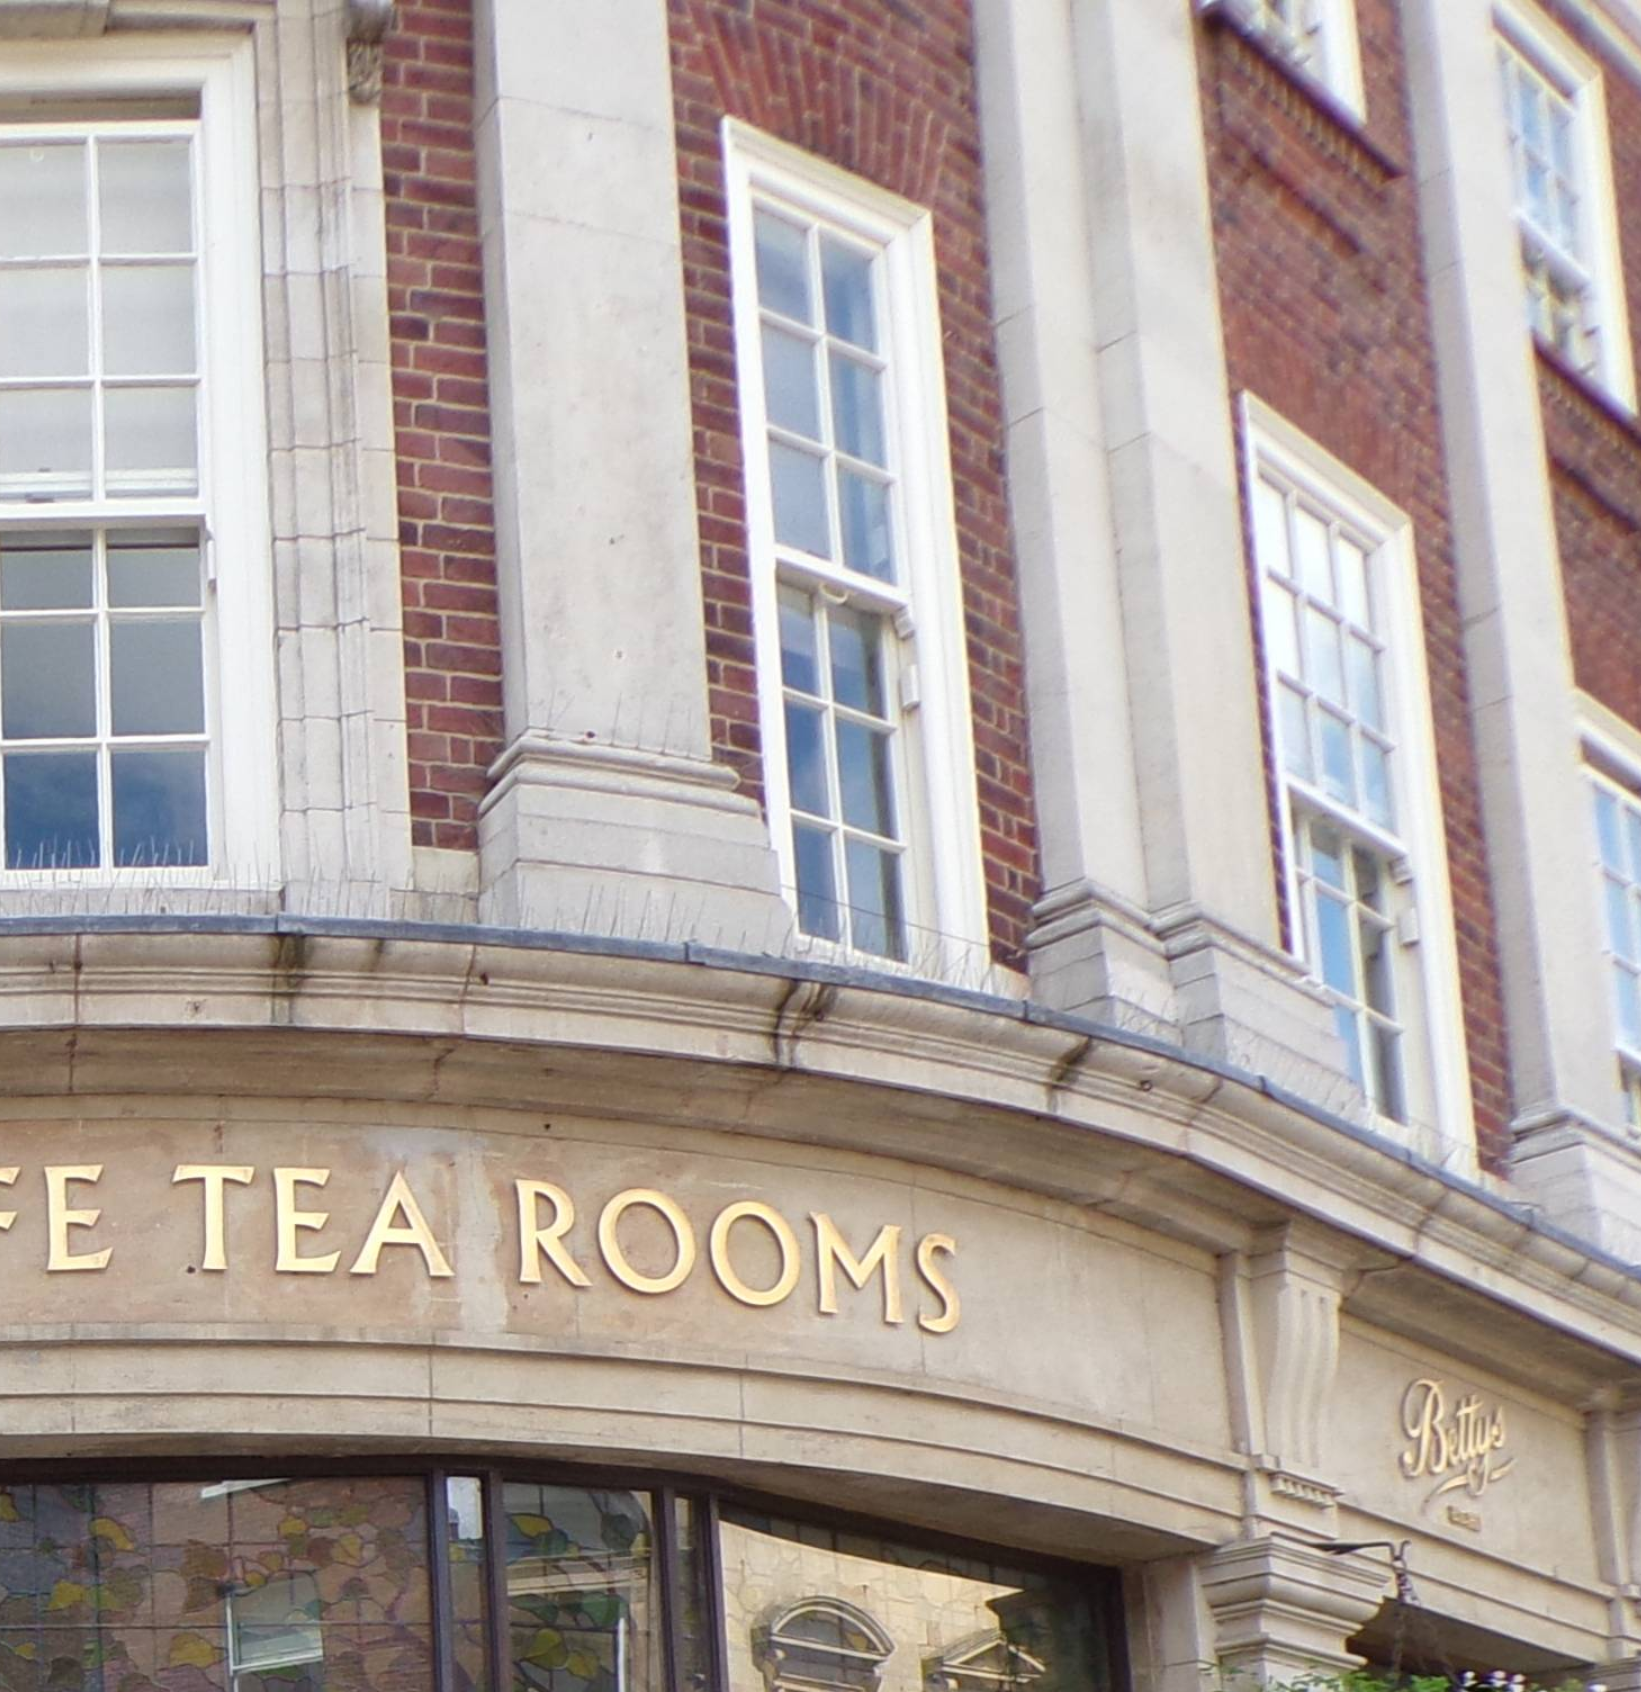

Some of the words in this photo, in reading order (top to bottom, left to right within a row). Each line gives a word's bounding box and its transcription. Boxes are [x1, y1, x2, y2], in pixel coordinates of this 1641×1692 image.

[172, 1163, 455, 1280] TEA
[514, 1178, 960, 1334] ROOMS
[1400, 1378, 1508, 1497] Bettys
